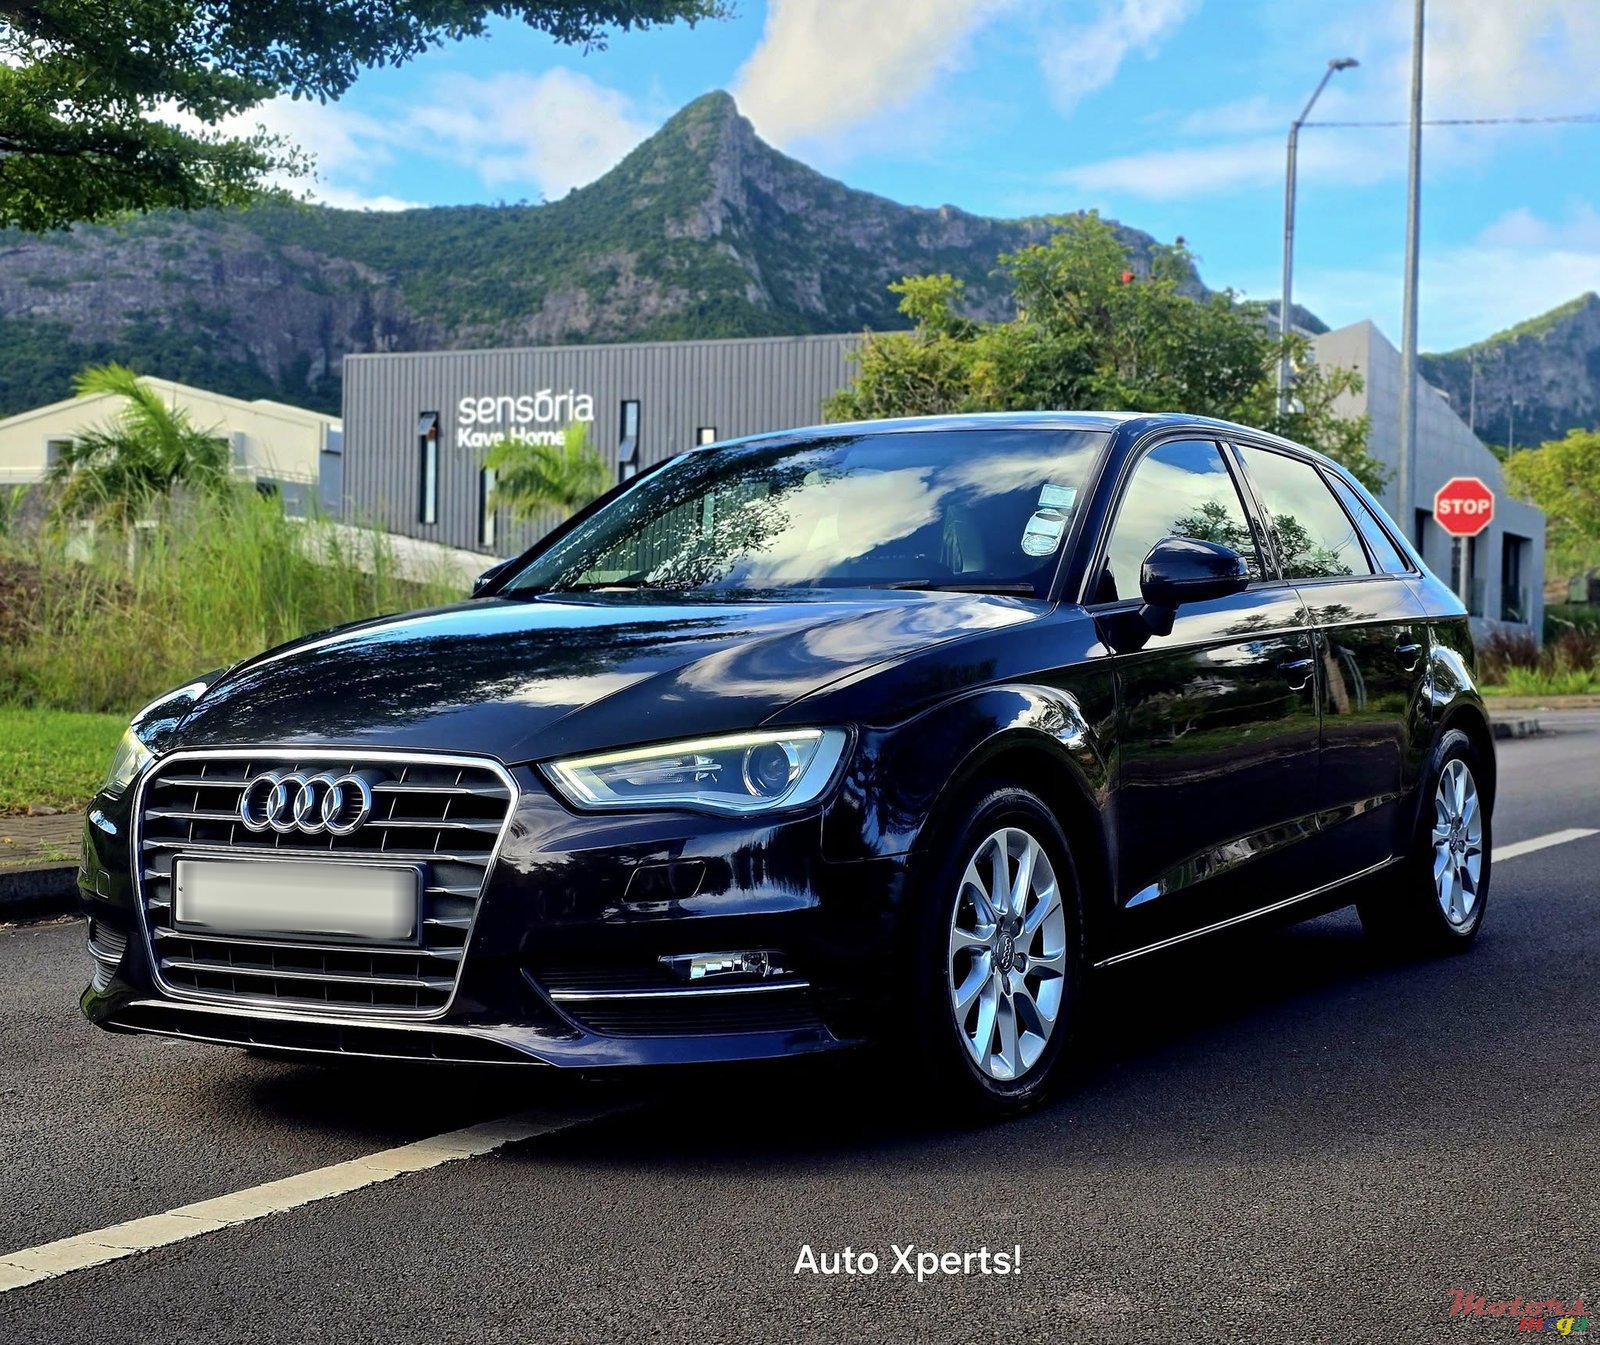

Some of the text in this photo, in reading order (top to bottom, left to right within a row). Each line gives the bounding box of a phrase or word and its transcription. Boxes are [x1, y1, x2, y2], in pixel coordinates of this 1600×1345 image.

[458, 389, 594, 424] sensória
[457, 426, 566, 447] Kave Home
[1439, 499, 1490, 515] STOP
